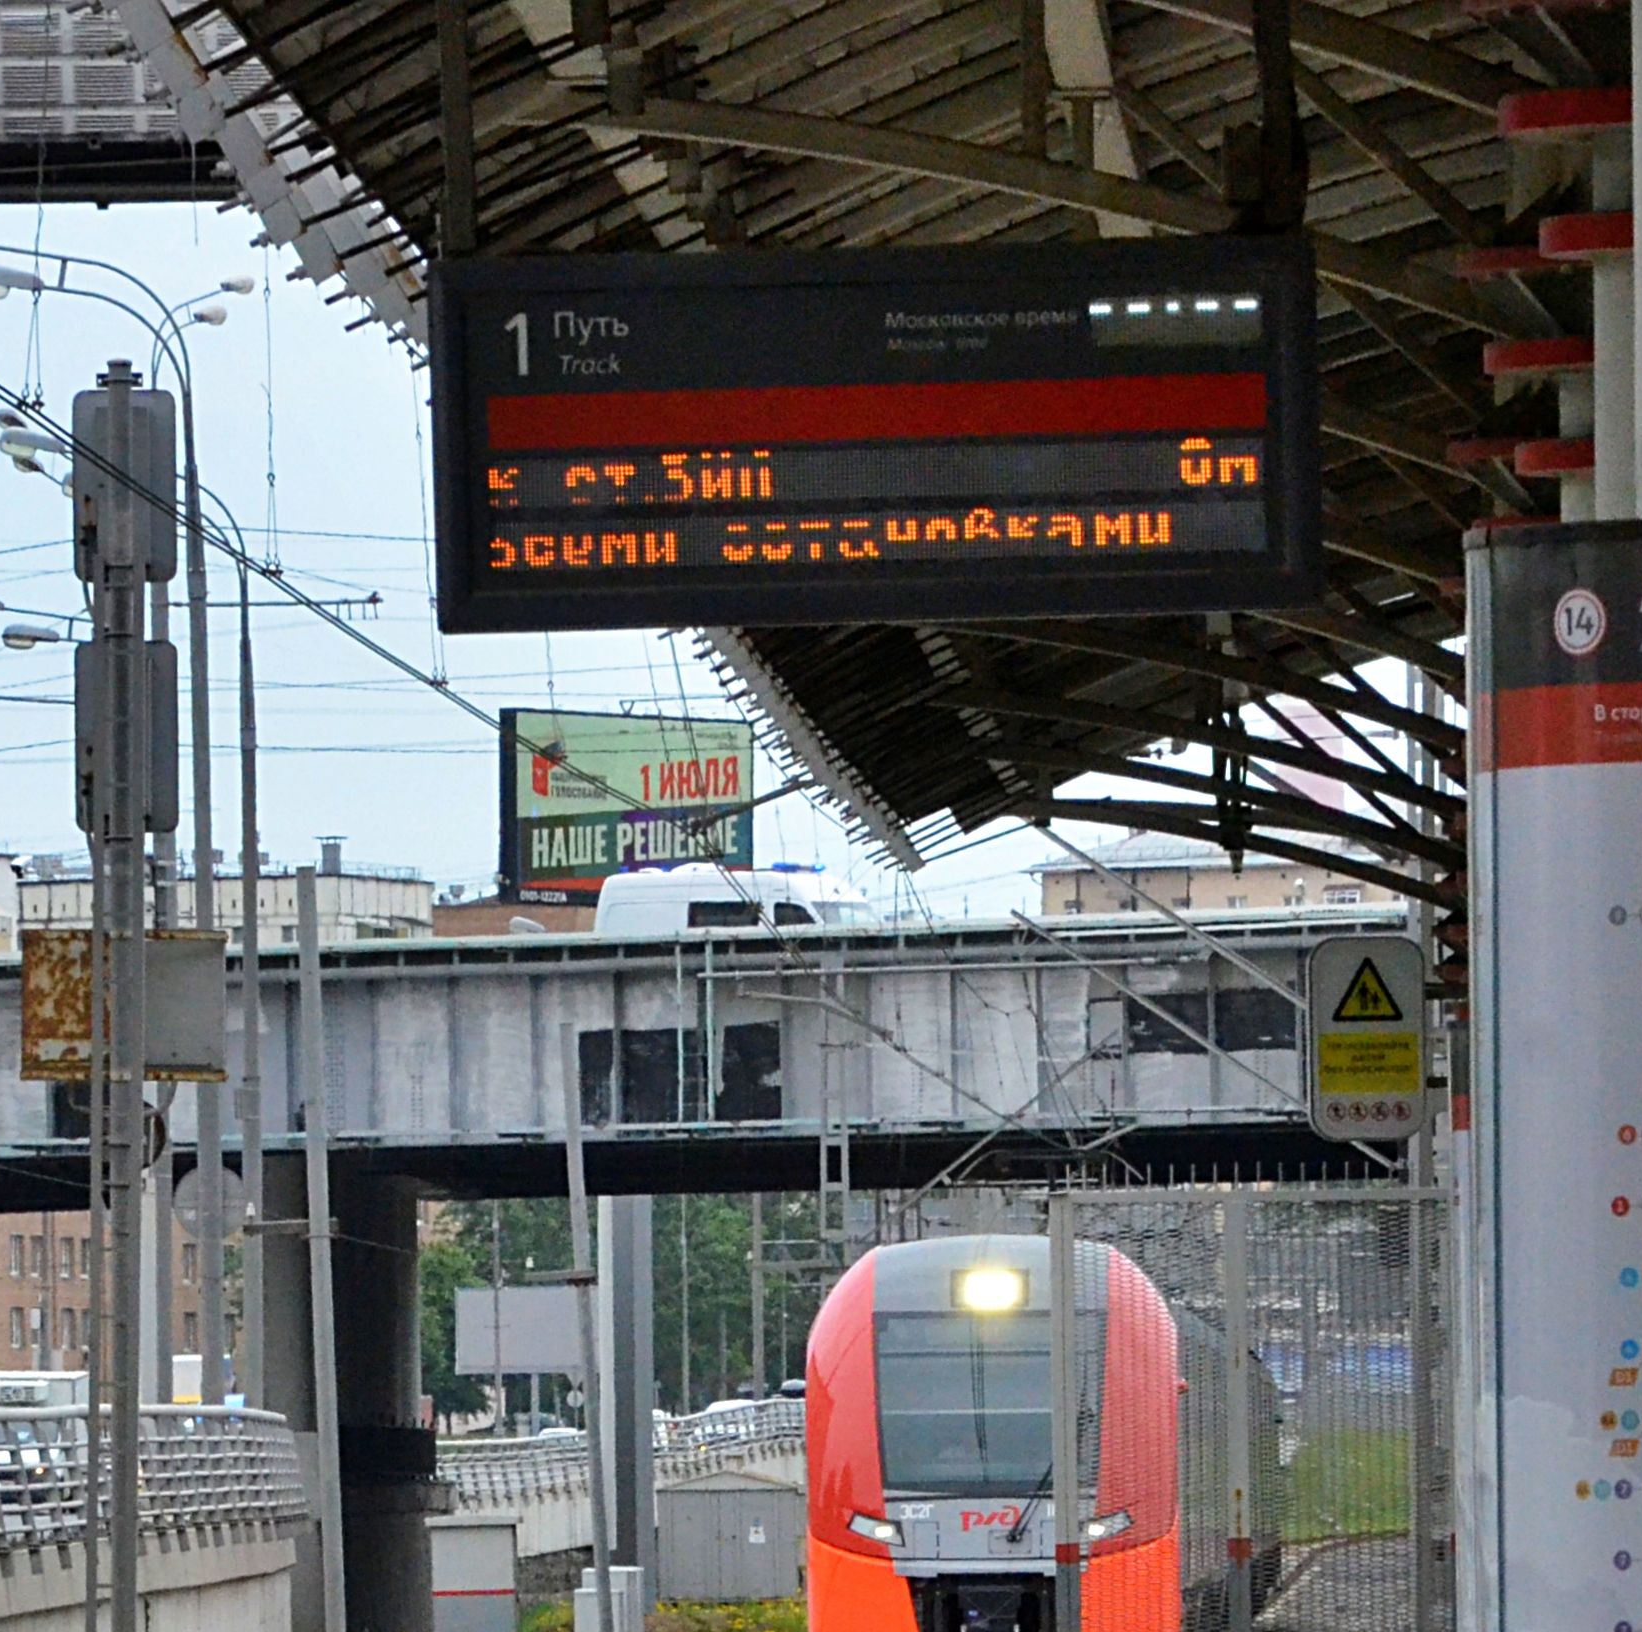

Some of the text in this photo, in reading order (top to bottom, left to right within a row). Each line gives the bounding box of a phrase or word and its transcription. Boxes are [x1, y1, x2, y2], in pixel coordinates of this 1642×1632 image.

[554, 311, 630, 346] Путь
[884, 310, 1009, 329] Московское
[504, 312, 528, 376] 1
[559, 354, 622, 375] Track
[1564, 607, 1595, 637] 14
[1593, 703, 1607, 722] В
[640, 755, 739, 801] 1 ИЮЛЯ
[531, 823, 608, 869] НАШЕ
